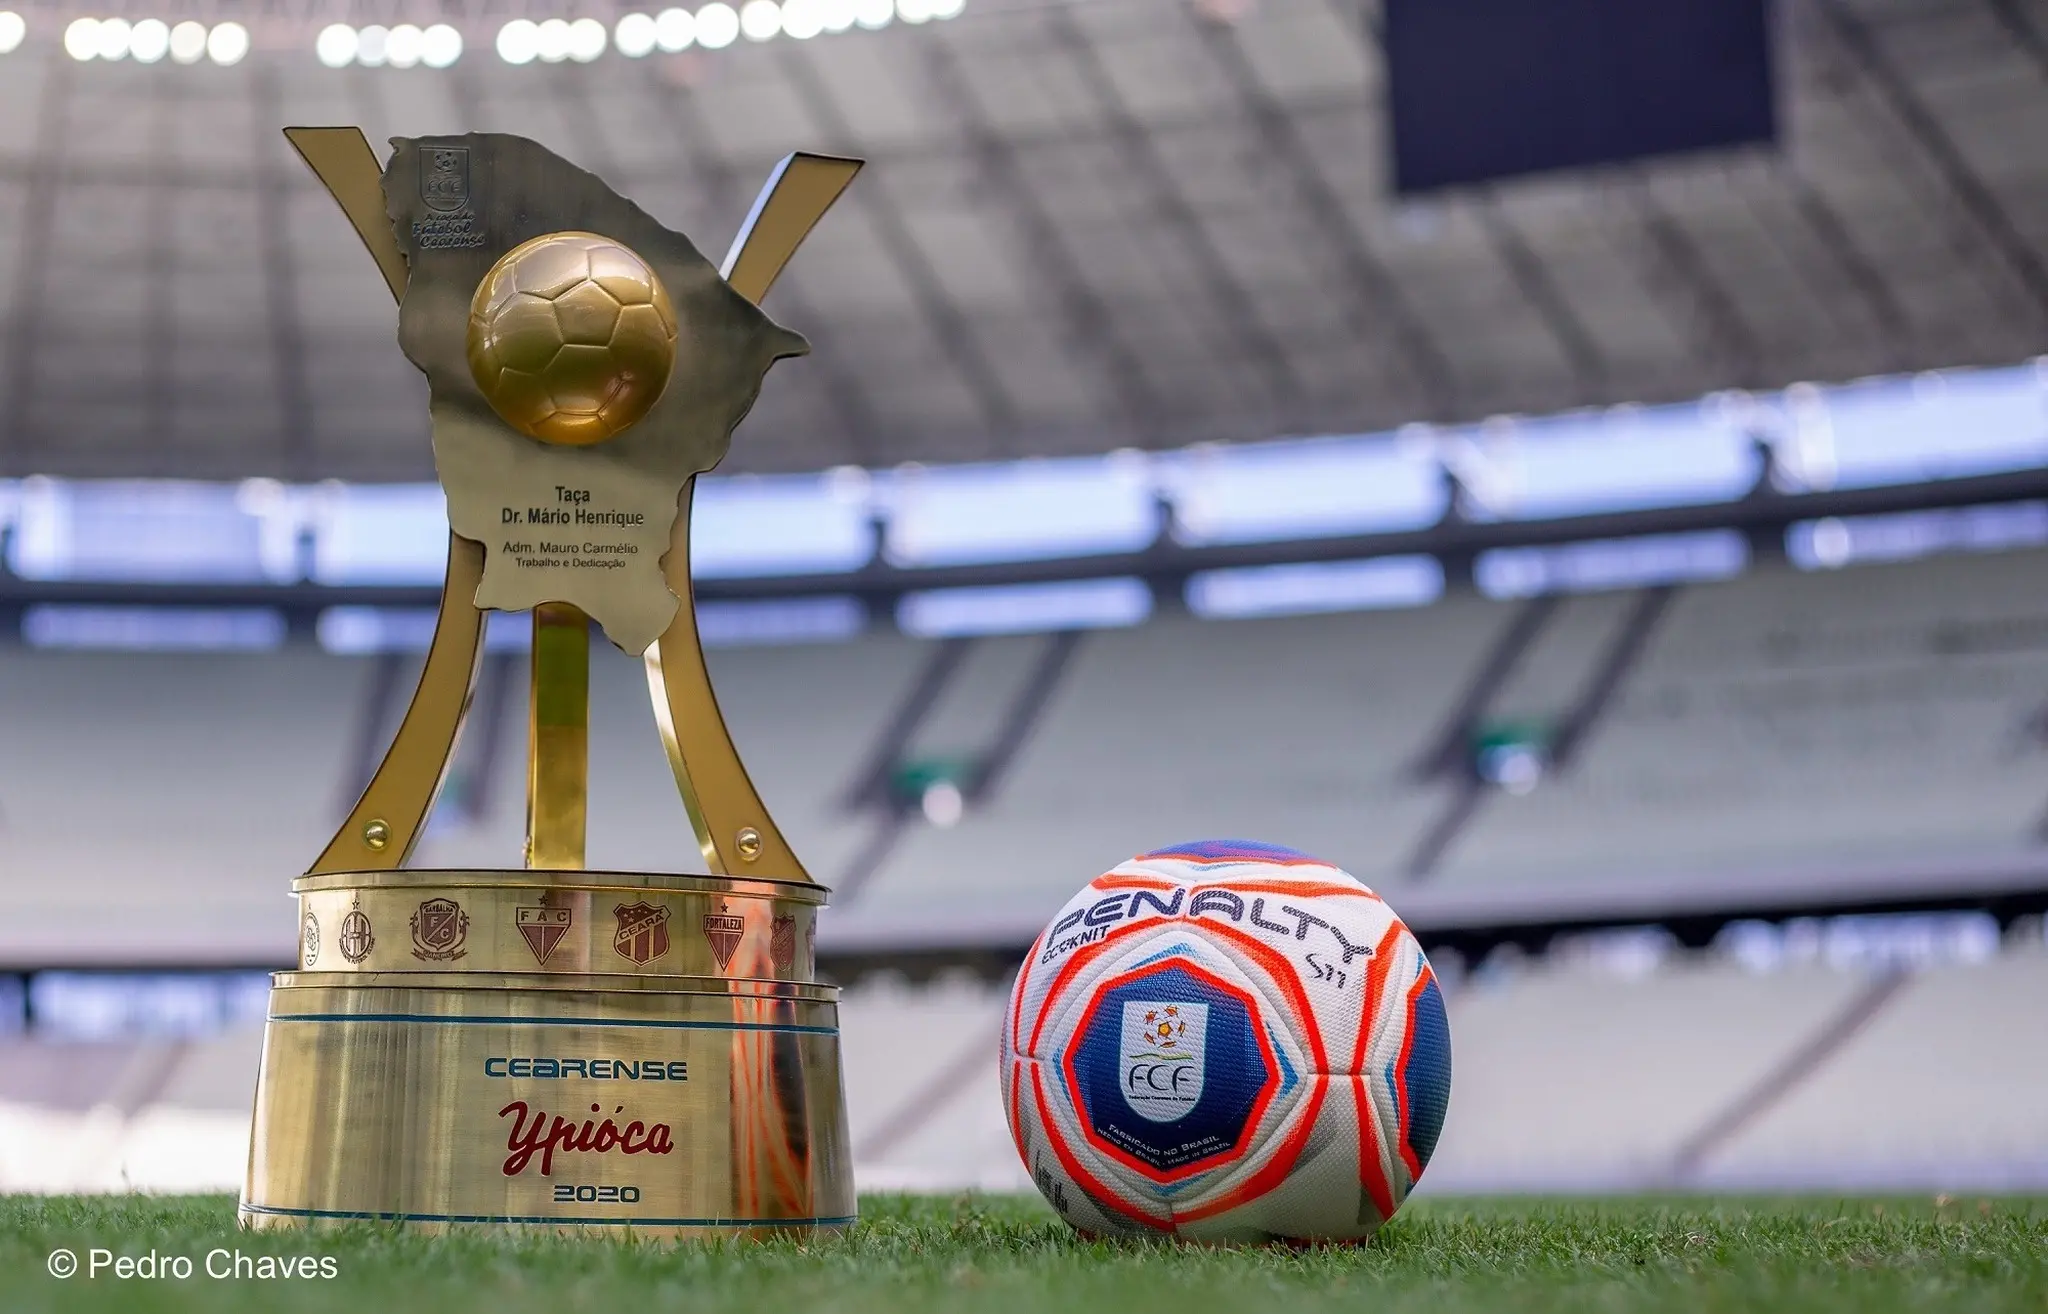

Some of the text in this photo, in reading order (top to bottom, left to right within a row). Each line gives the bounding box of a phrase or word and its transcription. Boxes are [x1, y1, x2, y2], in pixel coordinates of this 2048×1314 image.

[412, 221, 472, 235] Futebol
[420, 234, 486, 248] Cearense
[555, 485, 591, 506] Taça
[501, 507, 644, 528] Dr. Mário Henrique
[502, 541, 639, 555] Adm. Mauro Carmélio
[515, 557, 626, 570] Trabalho e Dedicação
[705, 917, 742, 931] FORTALEZA
[1046, 887, 1374, 965] PENALTY
[484, 1057, 688, 1082] CEARENSE
[1128, 1063, 1195, 1094] FCF
[498, 1100, 675, 1177] Ypióca
[1181, 1135, 1220, 1152] BRASIL
[553, 1184, 641, 1204] 2020
